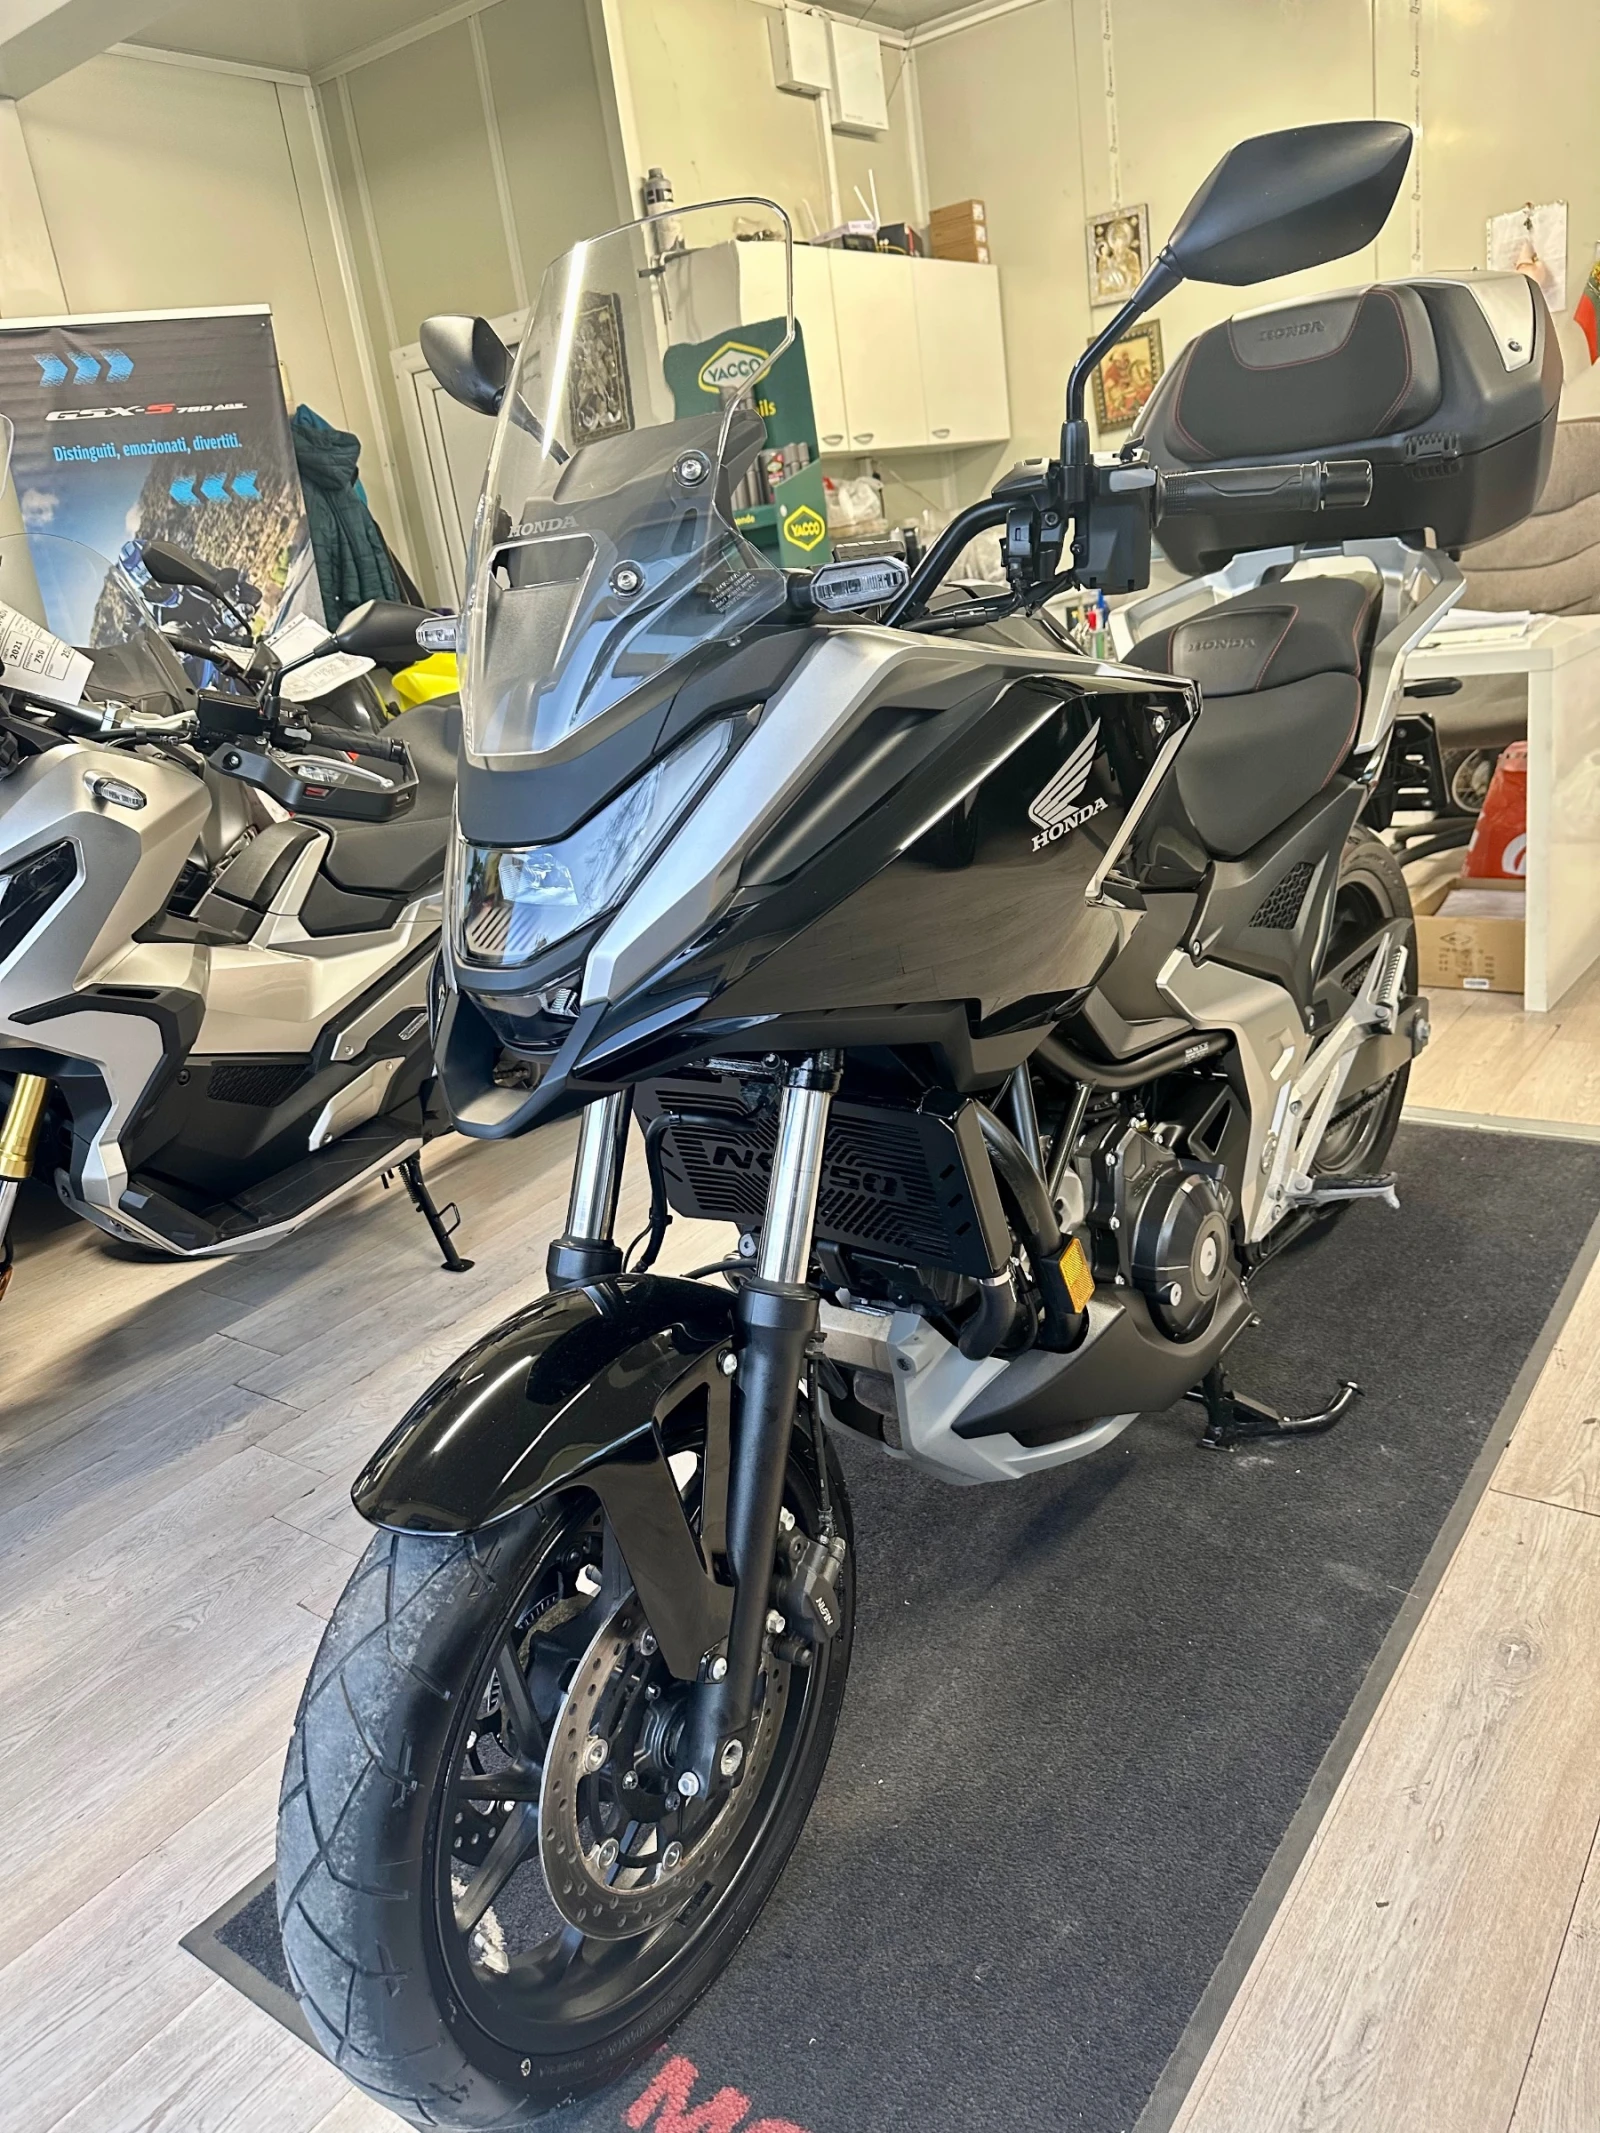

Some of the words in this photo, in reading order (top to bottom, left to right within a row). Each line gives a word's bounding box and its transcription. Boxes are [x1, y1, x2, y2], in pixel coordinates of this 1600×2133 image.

[1257, 320, 1326, 342] HONDA
[708, 358, 763, 382] YACCO
[756, 398, 777, 417] ils
[53, 442, 121, 464] Distinguiti,
[123, 436, 191, 458] emozionati,
[192, 432, 243, 452] divertiti.
[507, 515, 579, 539] HONDA
[791, 523, 820, 537] YACCO
[10, 641, 23, 660] 2021
[1188, 638, 1257, 653] HONDA
[1031, 797, 1109, 852] HONDA
